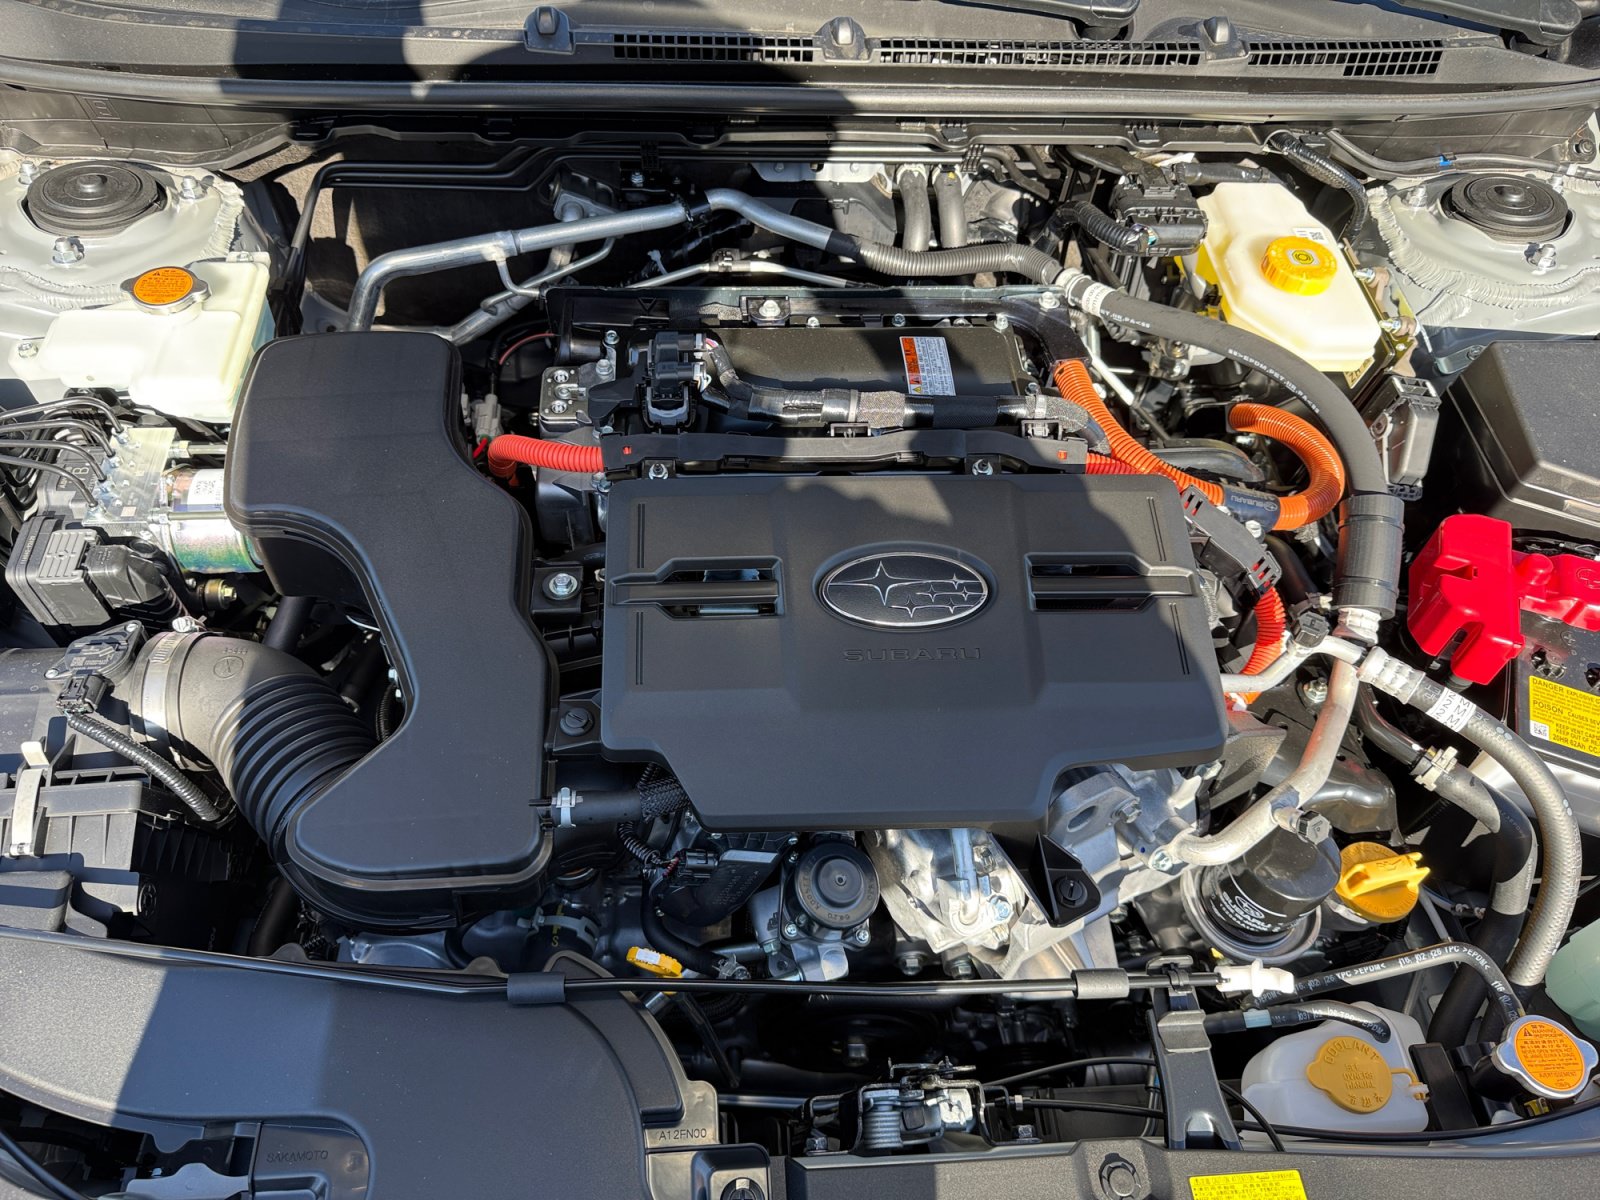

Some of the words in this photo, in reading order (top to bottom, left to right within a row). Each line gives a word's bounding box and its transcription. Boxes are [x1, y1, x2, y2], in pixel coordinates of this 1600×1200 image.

[842, 648, 982, 662] SUBARU
[1532, 678, 1564, 693] DANGER
[1454, 704, 1467, 717] M
[1532, 700, 1564, 715] POISON
[1446, 714, 1460, 726] M
[1222, 891, 1272, 928] SUBARU
[1323, 1039, 1380, 1065] COOLANT
[658, 1128, 708, 1141] A12FN00
[266, 1149, 329, 1163] SAKAMOTO
